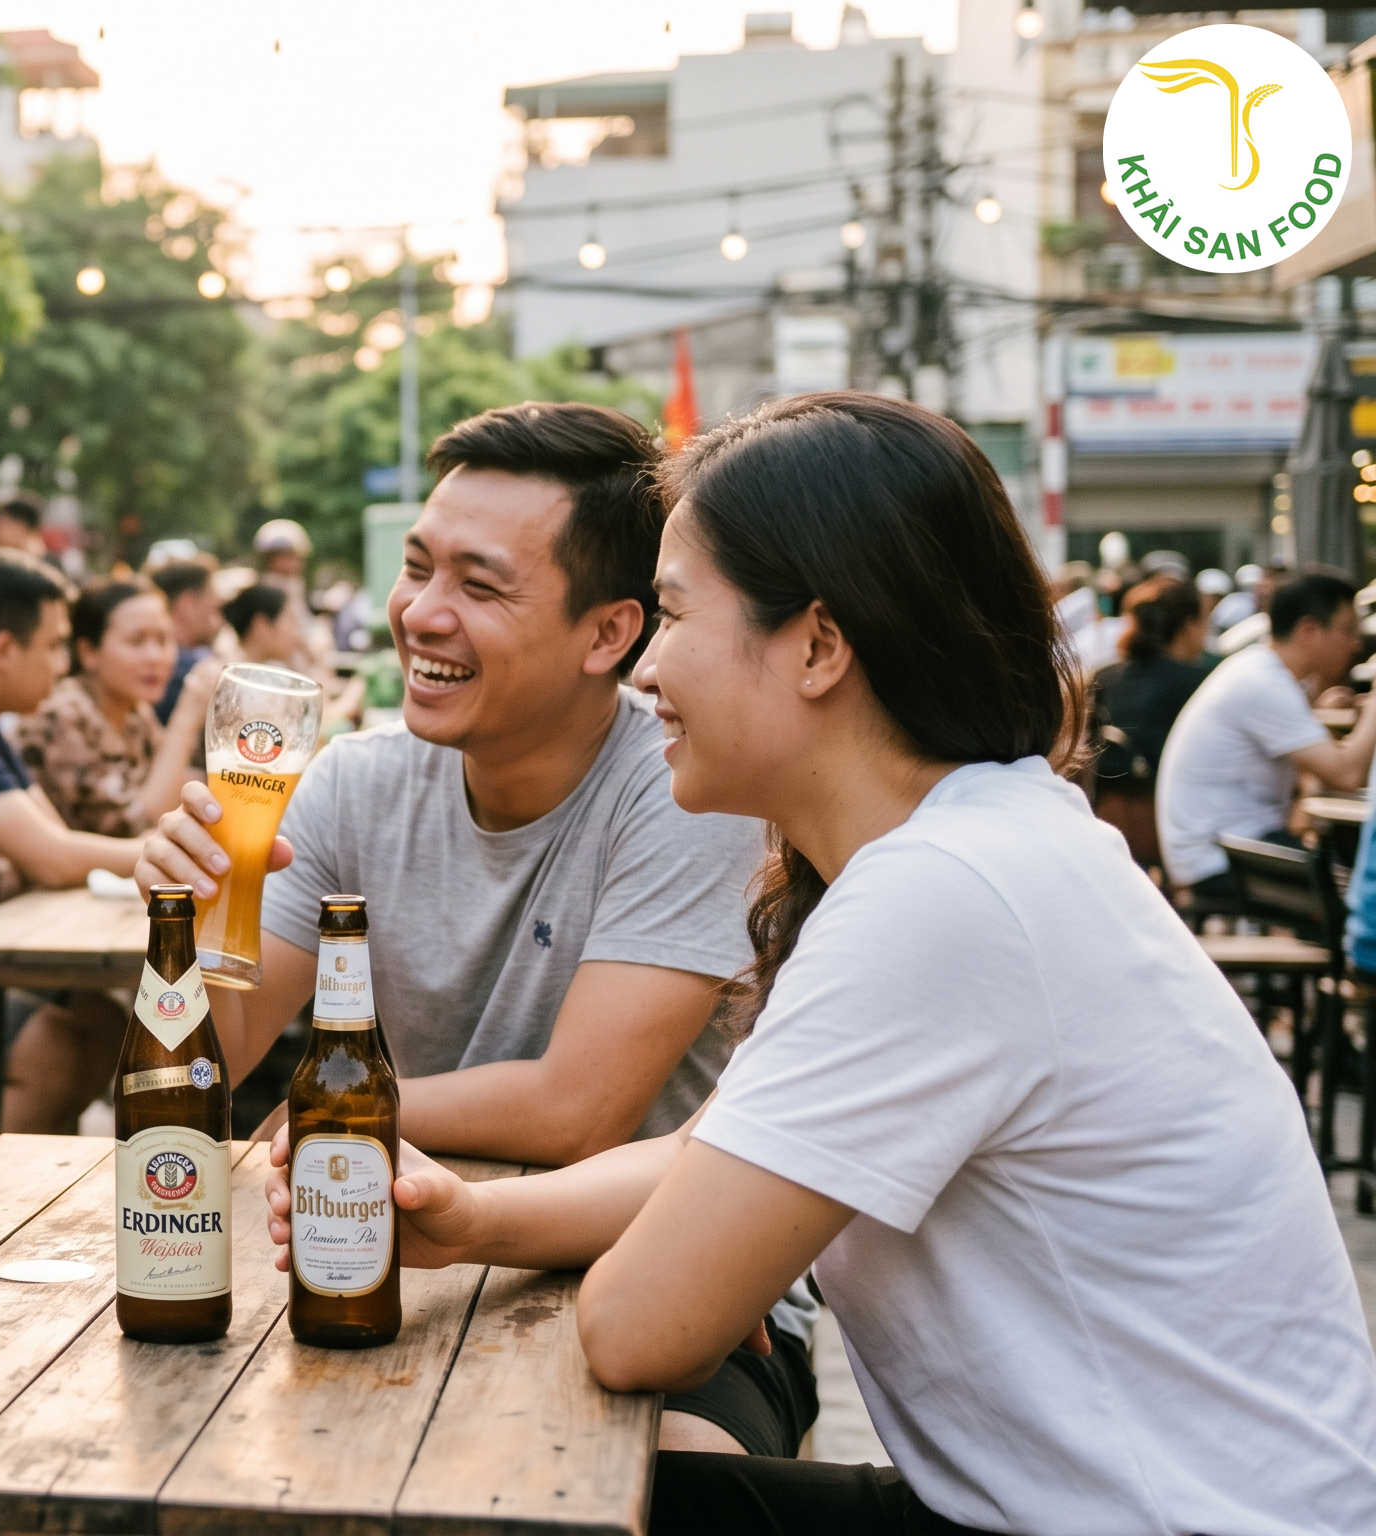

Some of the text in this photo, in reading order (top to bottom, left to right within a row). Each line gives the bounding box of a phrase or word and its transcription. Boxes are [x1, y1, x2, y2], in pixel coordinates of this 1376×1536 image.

[220, 768, 286, 795] ERDINGER
[295, 1185, 386, 1223] Bitburger
[122, 1206, 223, 1235] ERDINGER
[300, 1224, 348, 1244] Premium
